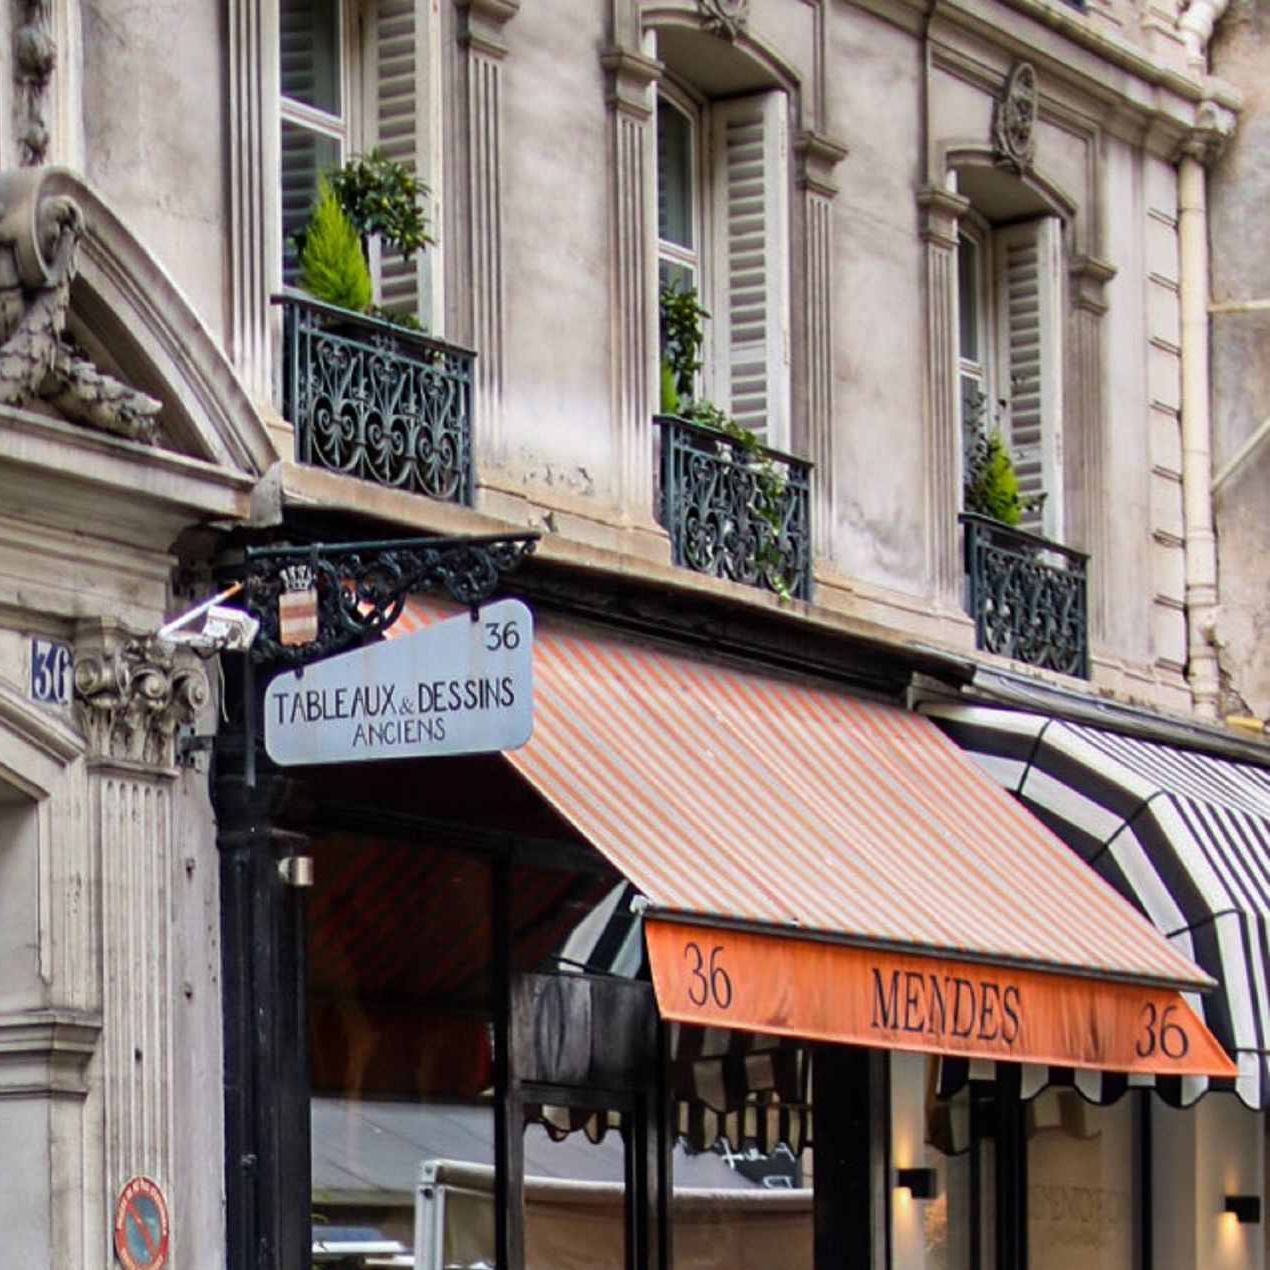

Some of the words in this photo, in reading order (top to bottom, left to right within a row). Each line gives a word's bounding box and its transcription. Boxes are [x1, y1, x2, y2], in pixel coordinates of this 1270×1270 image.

[486, 621, 521, 652] 36
[34, 640, 72, 702] 36
[272, 683, 396, 725] TABLEAUX
[398, 696, 417, 715] &
[417, 676, 515, 713] DESSINS
[352, 717, 447, 747] ANCIENS
[684, 941, 733, 1010] 36
[871, 967, 1021, 1045] MENDES
[1135, 1001, 1190, 1060] 36
